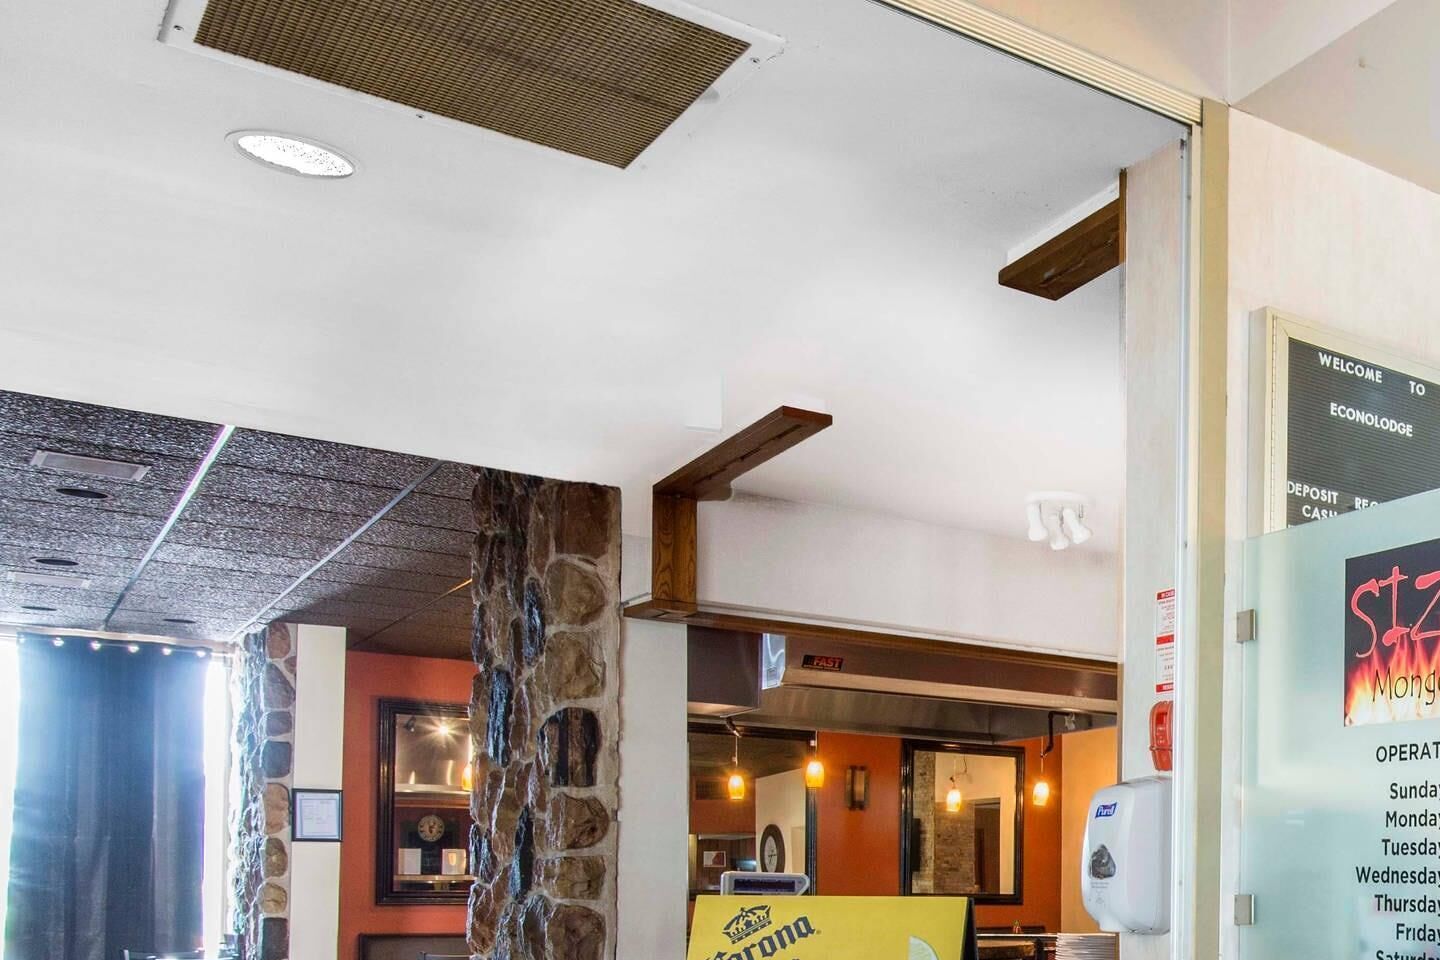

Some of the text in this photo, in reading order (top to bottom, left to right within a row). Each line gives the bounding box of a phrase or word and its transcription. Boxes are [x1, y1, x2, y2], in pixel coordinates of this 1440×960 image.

[1318, 352, 1426, 397] WELCOME TO
[1330, 402, 1413, 438] ECONOLODGE
[1287, 480, 1339, 505] DEPOSIT
